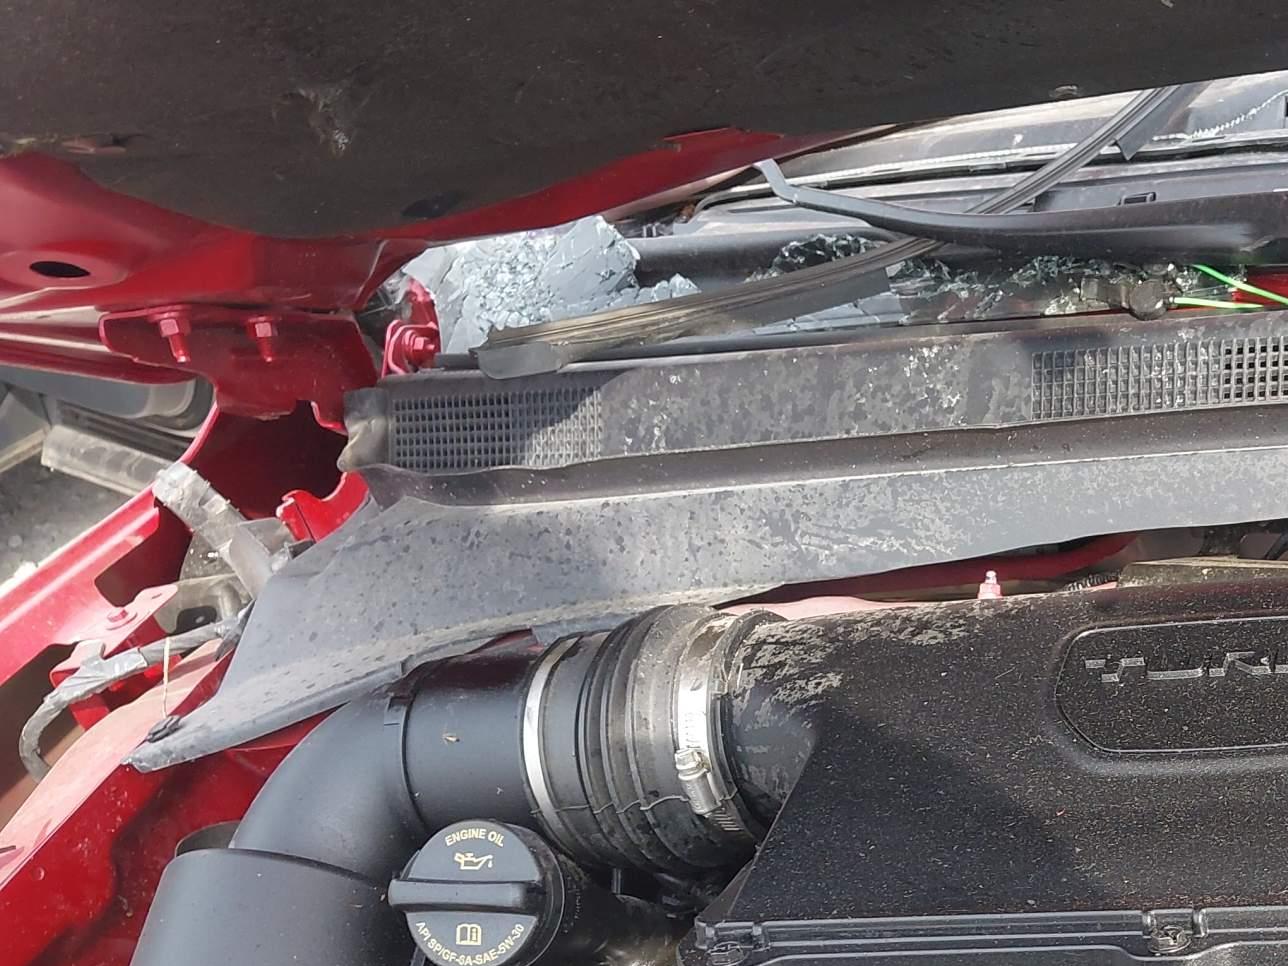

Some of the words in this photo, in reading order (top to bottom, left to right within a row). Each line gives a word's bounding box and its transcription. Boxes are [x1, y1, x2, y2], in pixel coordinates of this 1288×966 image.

[445, 828, 486, 847] ENGINE
[488, 829, 505, 847] OIL
[416, 921, 431, 941] API
